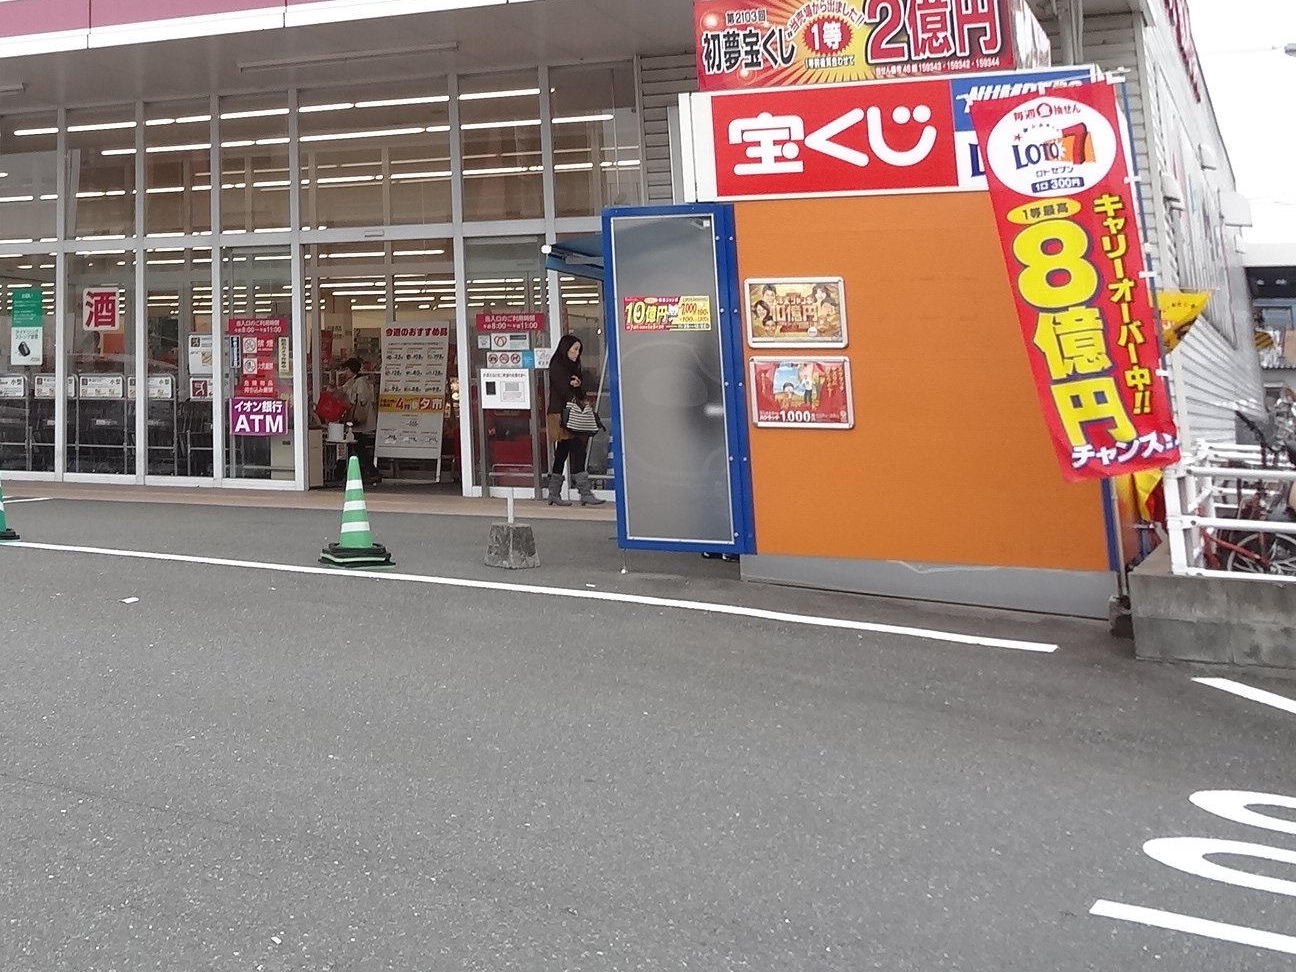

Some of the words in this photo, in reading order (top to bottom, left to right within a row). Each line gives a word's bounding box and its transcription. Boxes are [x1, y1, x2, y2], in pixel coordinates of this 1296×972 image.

[811, 22, 842, 50] 1等
[728, 104, 937, 175] 宝くじ
[1022, 202, 1069, 220] 1等最高
[85, 291, 116, 327] 酒
[1012, 218, 1138, 447] 8億円
[234, 400, 283, 413] イオン銀行
[234, 414, 284, 433] ATM
